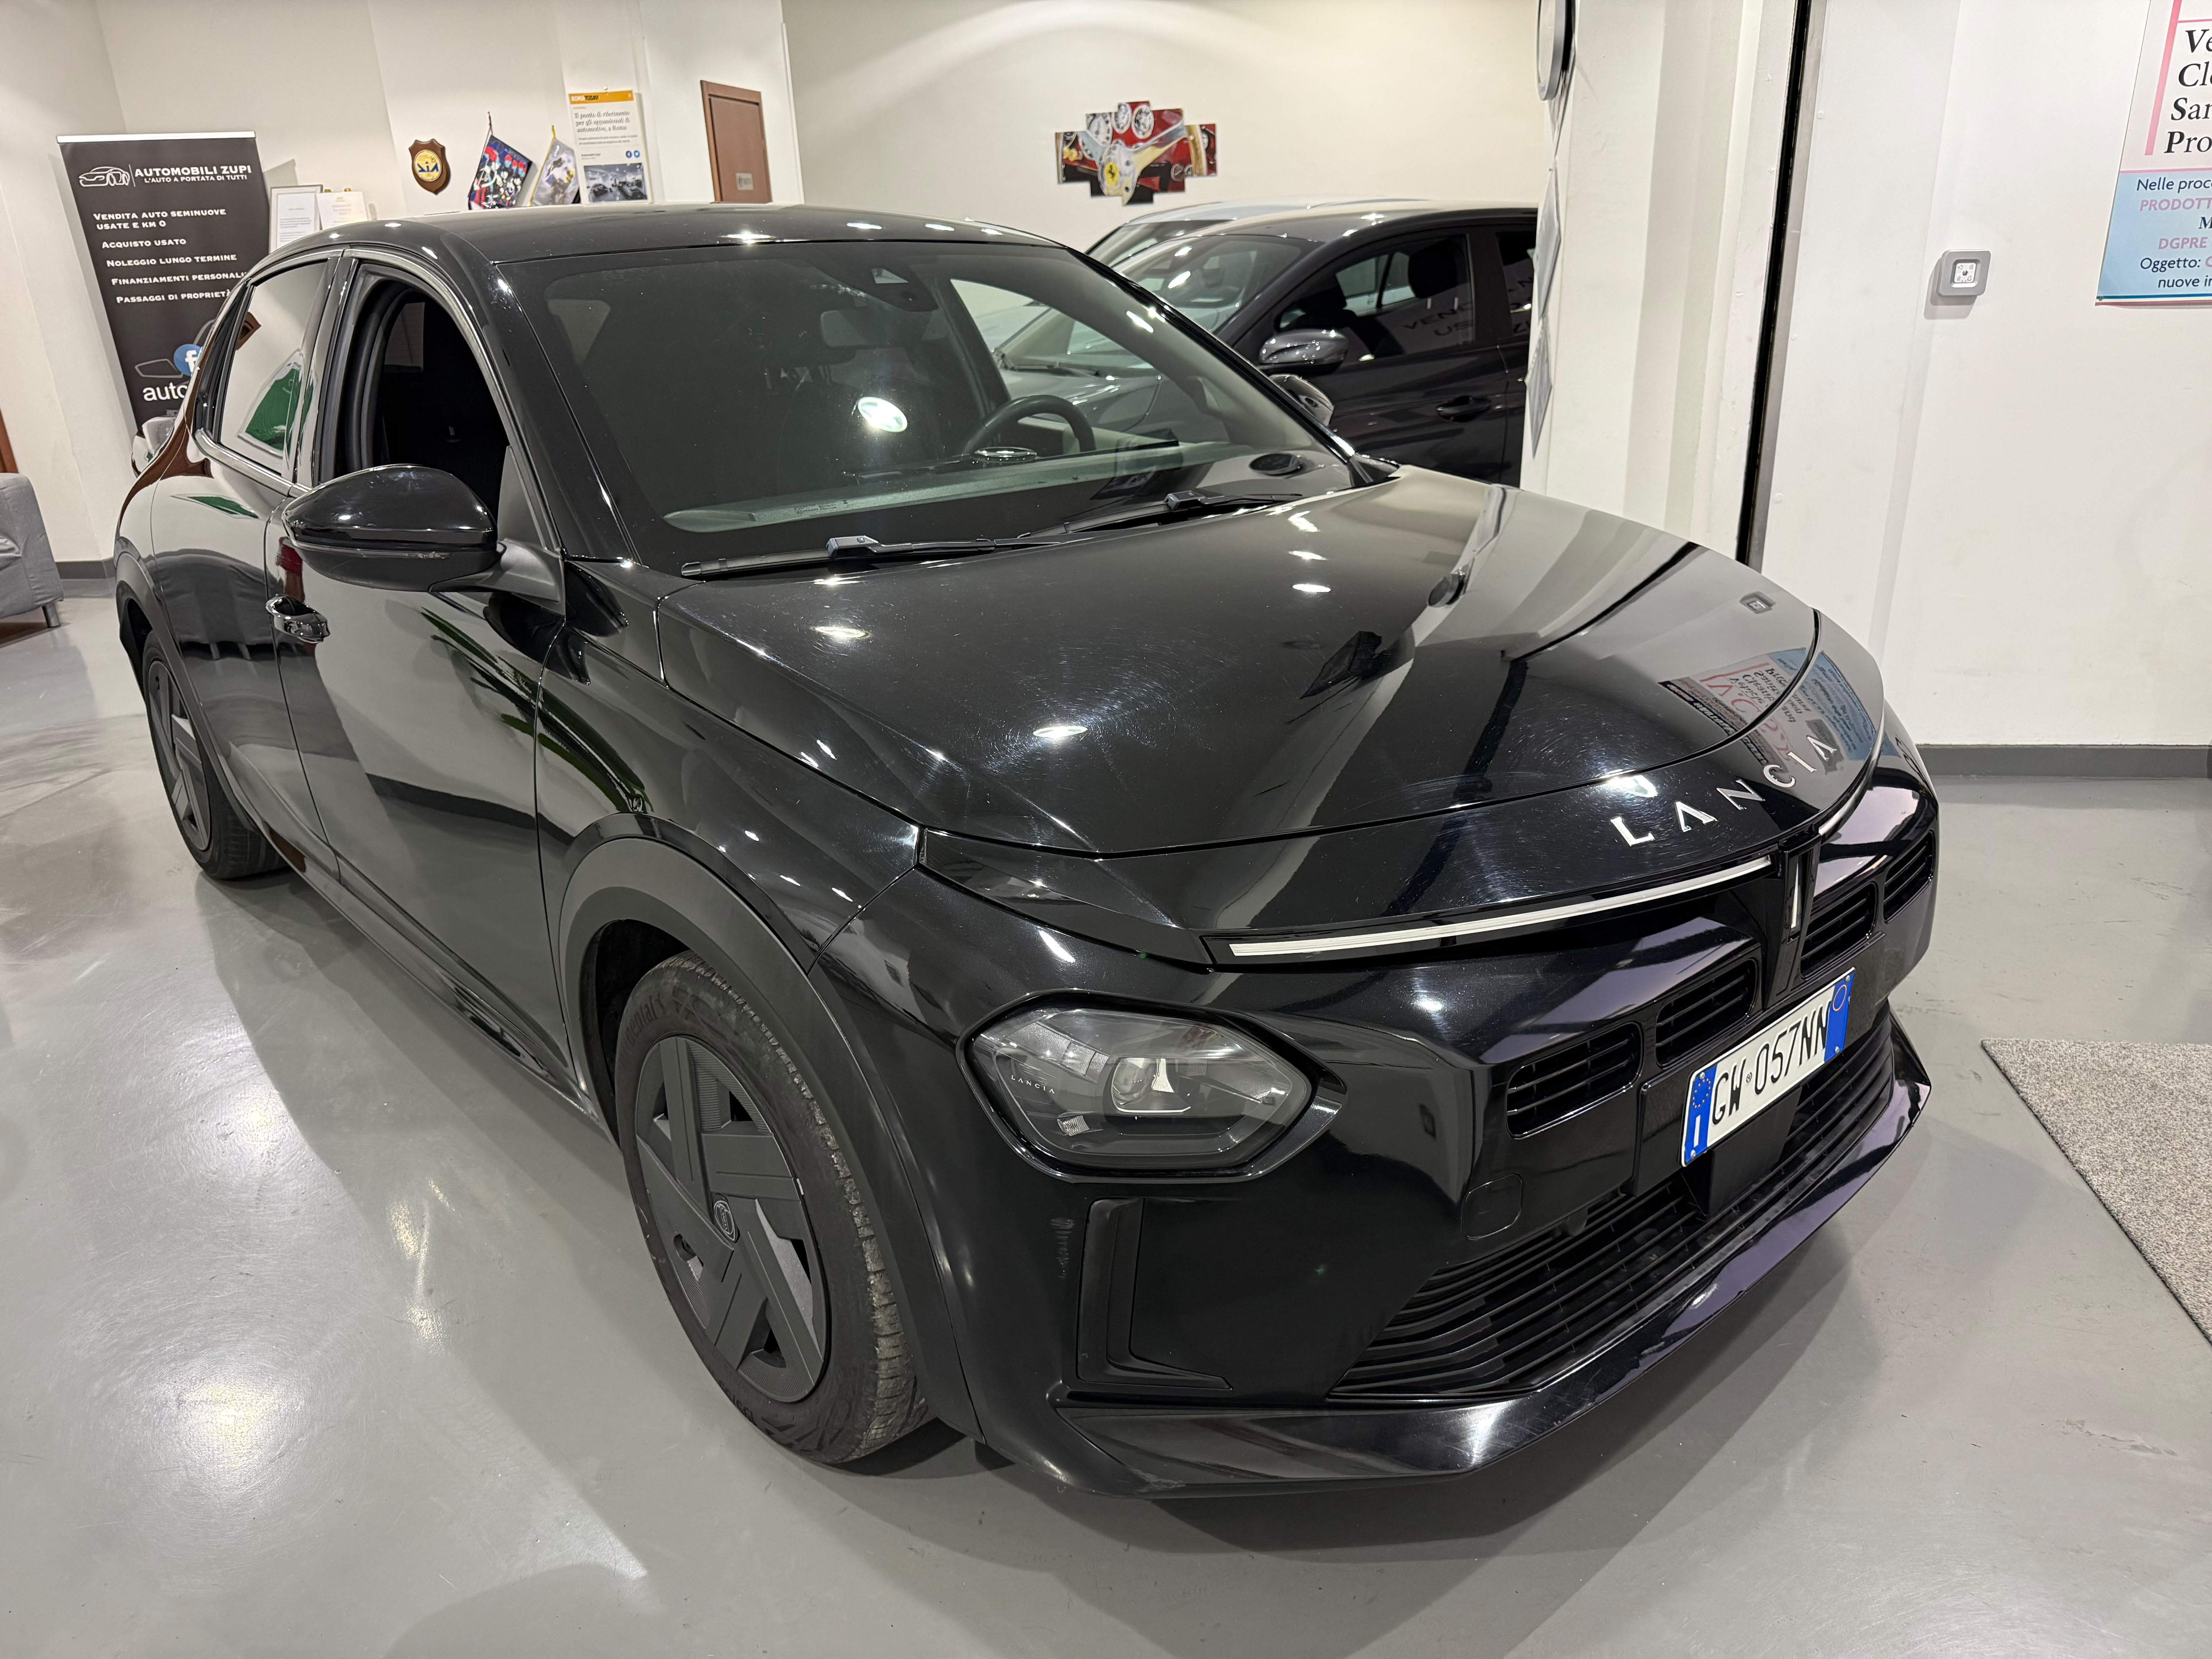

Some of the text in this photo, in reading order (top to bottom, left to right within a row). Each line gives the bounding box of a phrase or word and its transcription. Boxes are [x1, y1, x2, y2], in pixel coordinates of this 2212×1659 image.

[2178, 60, 2212, 87] Cl
[2164, 131, 2212, 153] Pro
[135, 165, 252, 177] AUTOMOBILI ZUPI
[2137, 177, 2212, 194] Nelle proc
[170, 209, 226, 217] SEMINUOVE
[102, 240, 151, 249] ACQUISTO
[2158, 237, 2208, 250] DGPRE
[106, 258, 157, 267] NOLEGGIO
[194, 254, 237, 262] TERMINE
[2140, 257, 2201, 273] Oggetto:
[111, 272, 247, 285] FINANZIAMENTI PERSONALI
[2158, 278, 2200, 288] nuove
[116, 295, 165, 303] PASSAGGI
[1610, 735, 1837, 847] LANCIA
[1011, 1075, 1055, 1094] LANCIA
